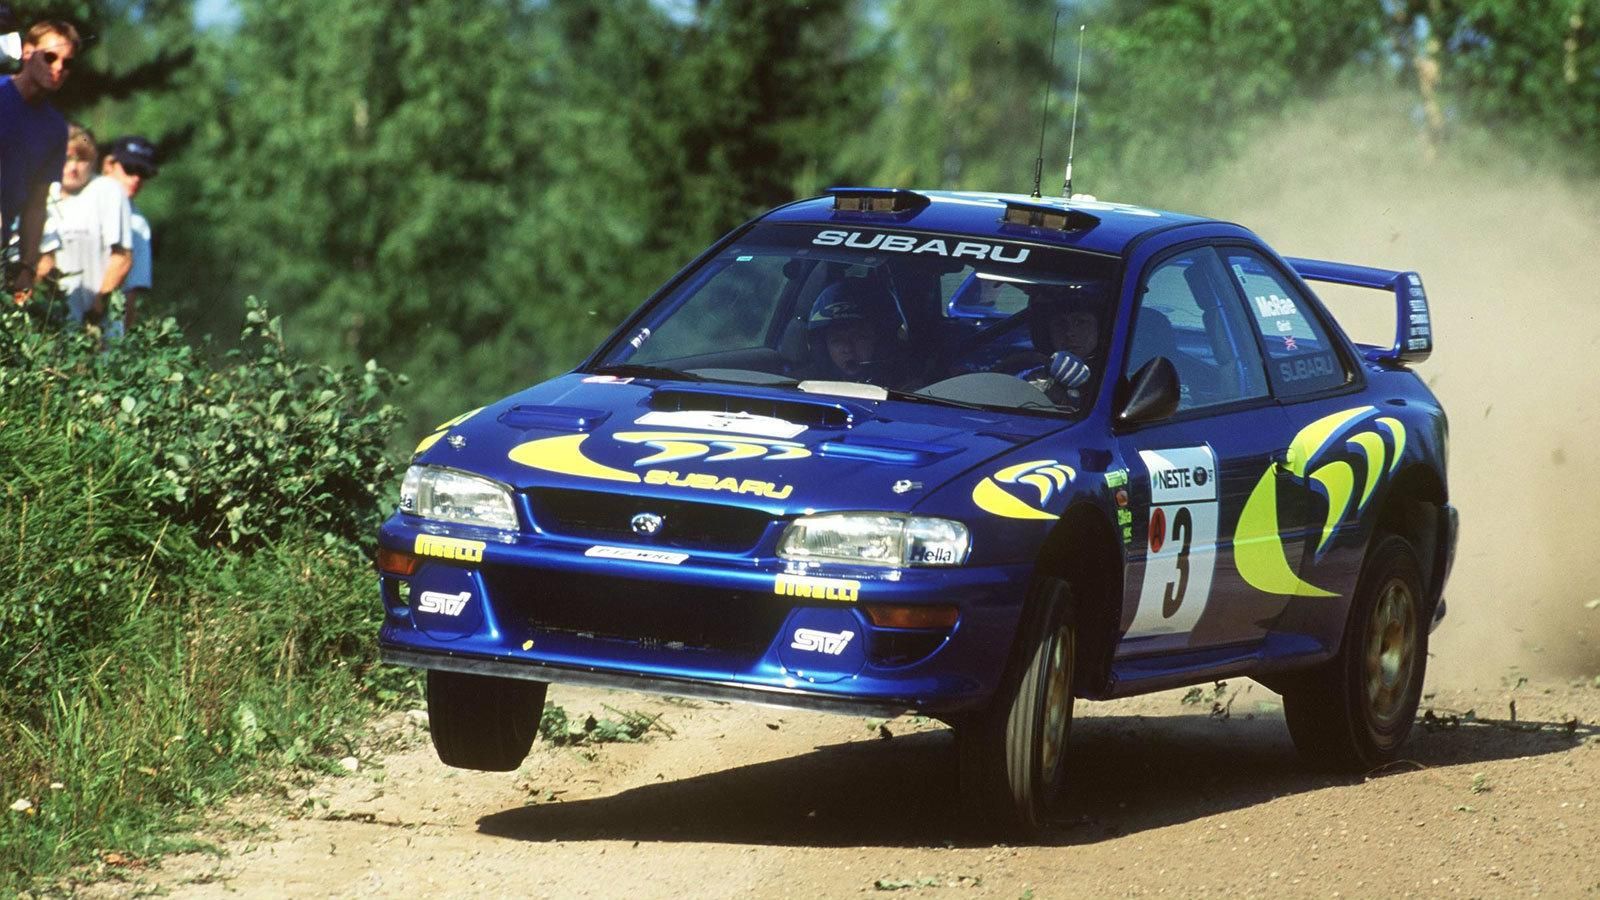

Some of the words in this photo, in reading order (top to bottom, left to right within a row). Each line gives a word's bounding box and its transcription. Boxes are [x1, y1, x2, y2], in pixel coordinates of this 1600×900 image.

[812, 230, 1030, 263] SUBARU
[1255, 295, 1297, 317] McRae
[1279, 355, 1334, 382] SUBARU
[643, 470, 794, 500] SUBARU
[1158, 468, 1191, 489] NESTE
[415, 533, 486, 562] PIRELLI
[911, 547, 952, 562] Hella
[1163, 507, 1192, 619] 3
[774, 573, 861, 602] PIRELLI
